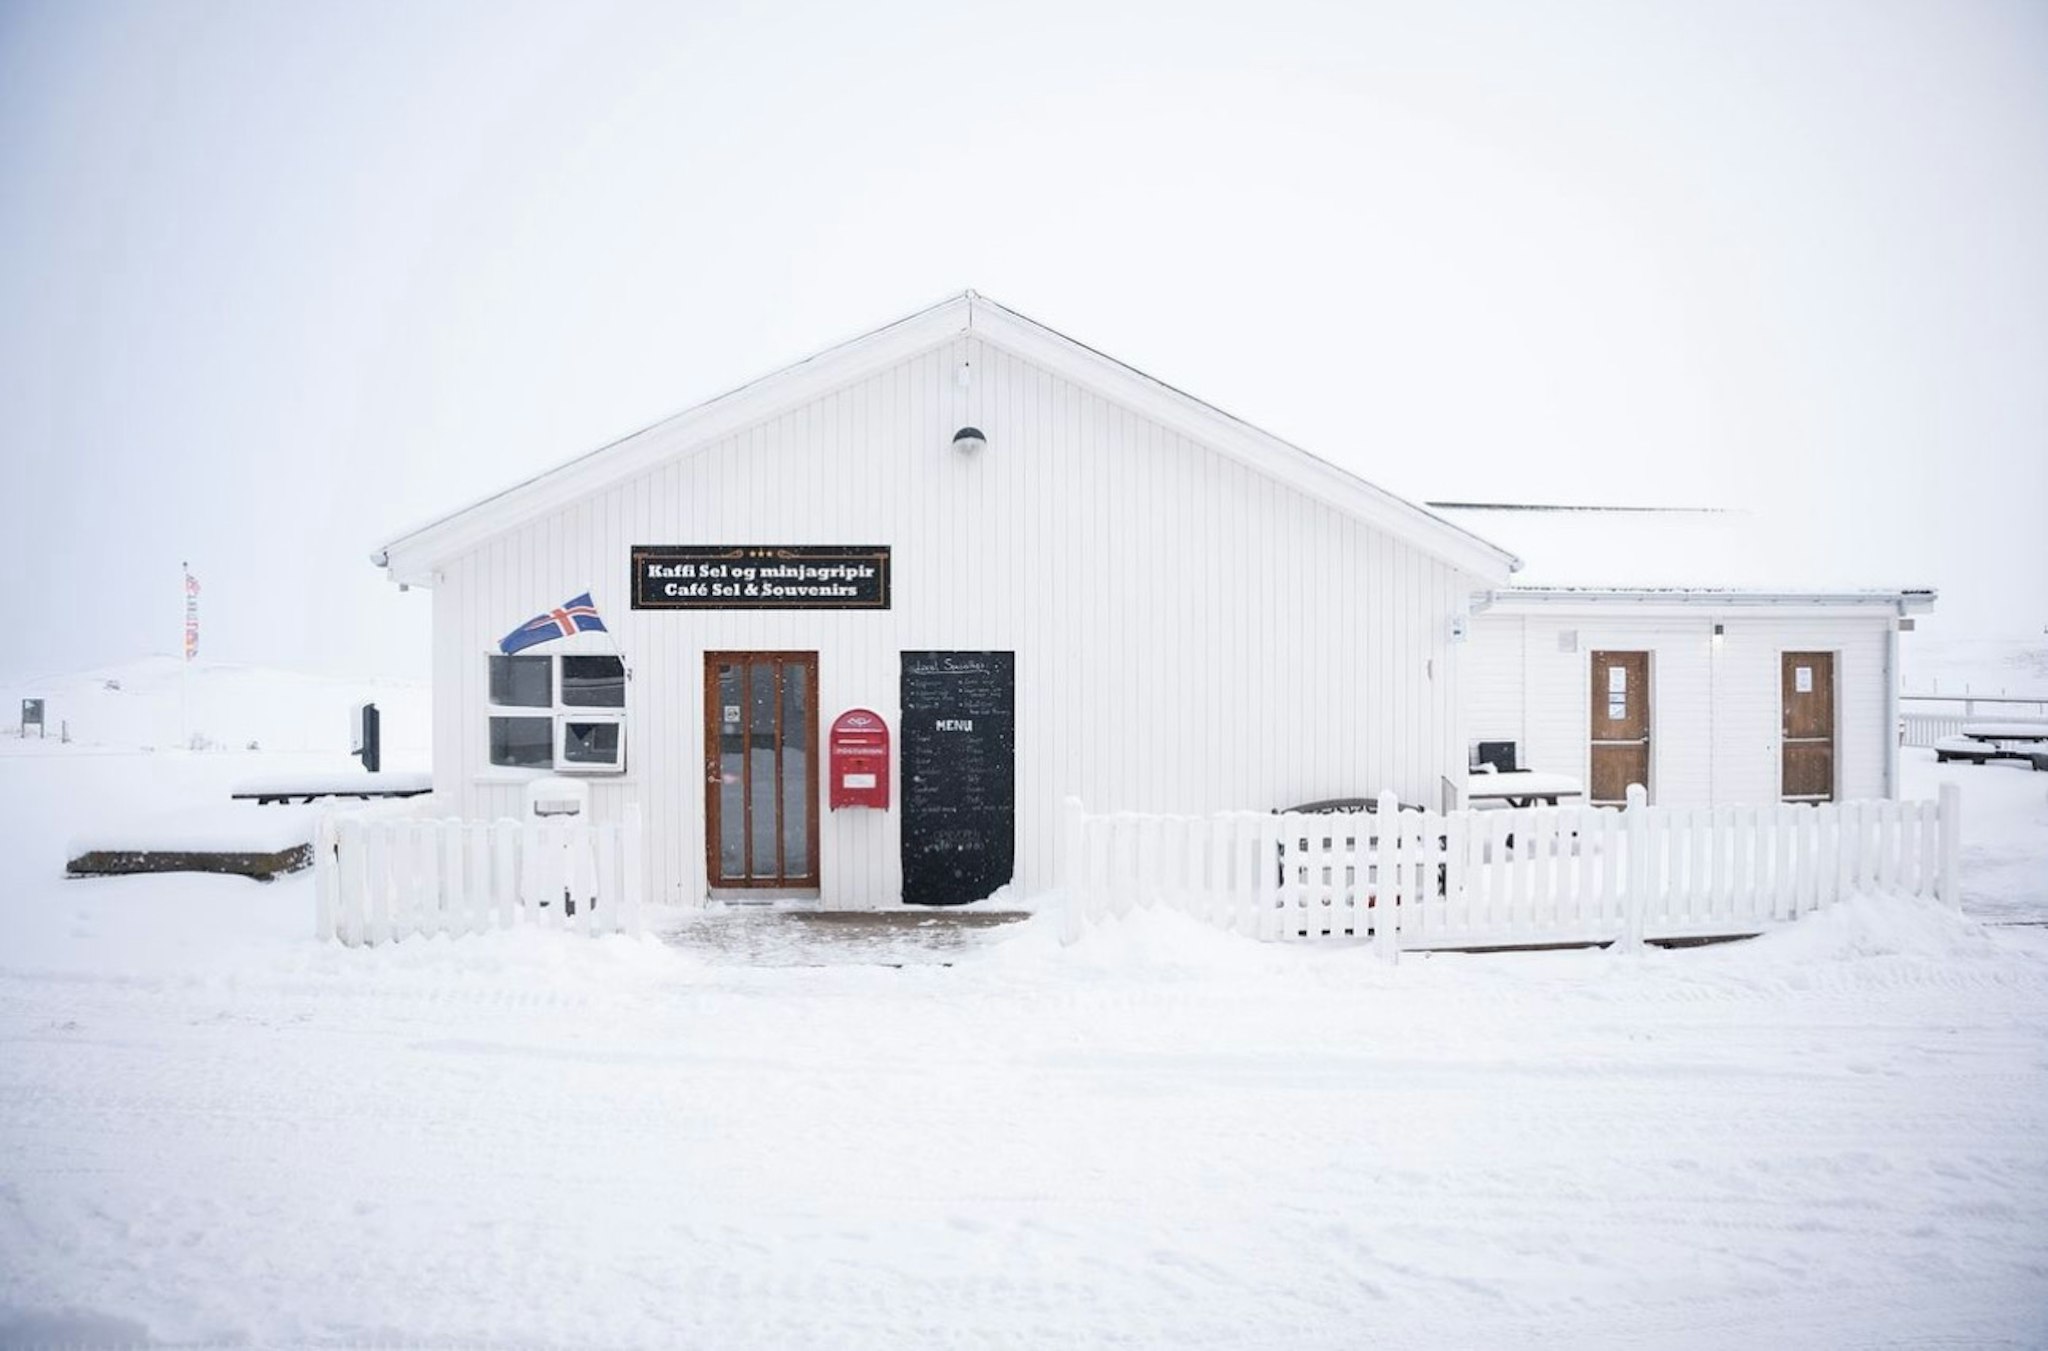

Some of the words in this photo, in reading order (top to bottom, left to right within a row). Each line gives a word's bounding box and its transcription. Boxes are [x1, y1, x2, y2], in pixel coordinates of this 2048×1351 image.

[648, 564, 695, 578] Kaffi
[700, 564, 727, 578] Sel
[731, 567, 755, 580] og
[760, 564, 875, 580] minjagripir
[664, 583, 708, 596] Café
[712, 583, 741, 596] Sel
[744, 583, 759, 597] &
[762, 582, 858, 597] Souvenirs
[936, 720, 973, 731] MENU
